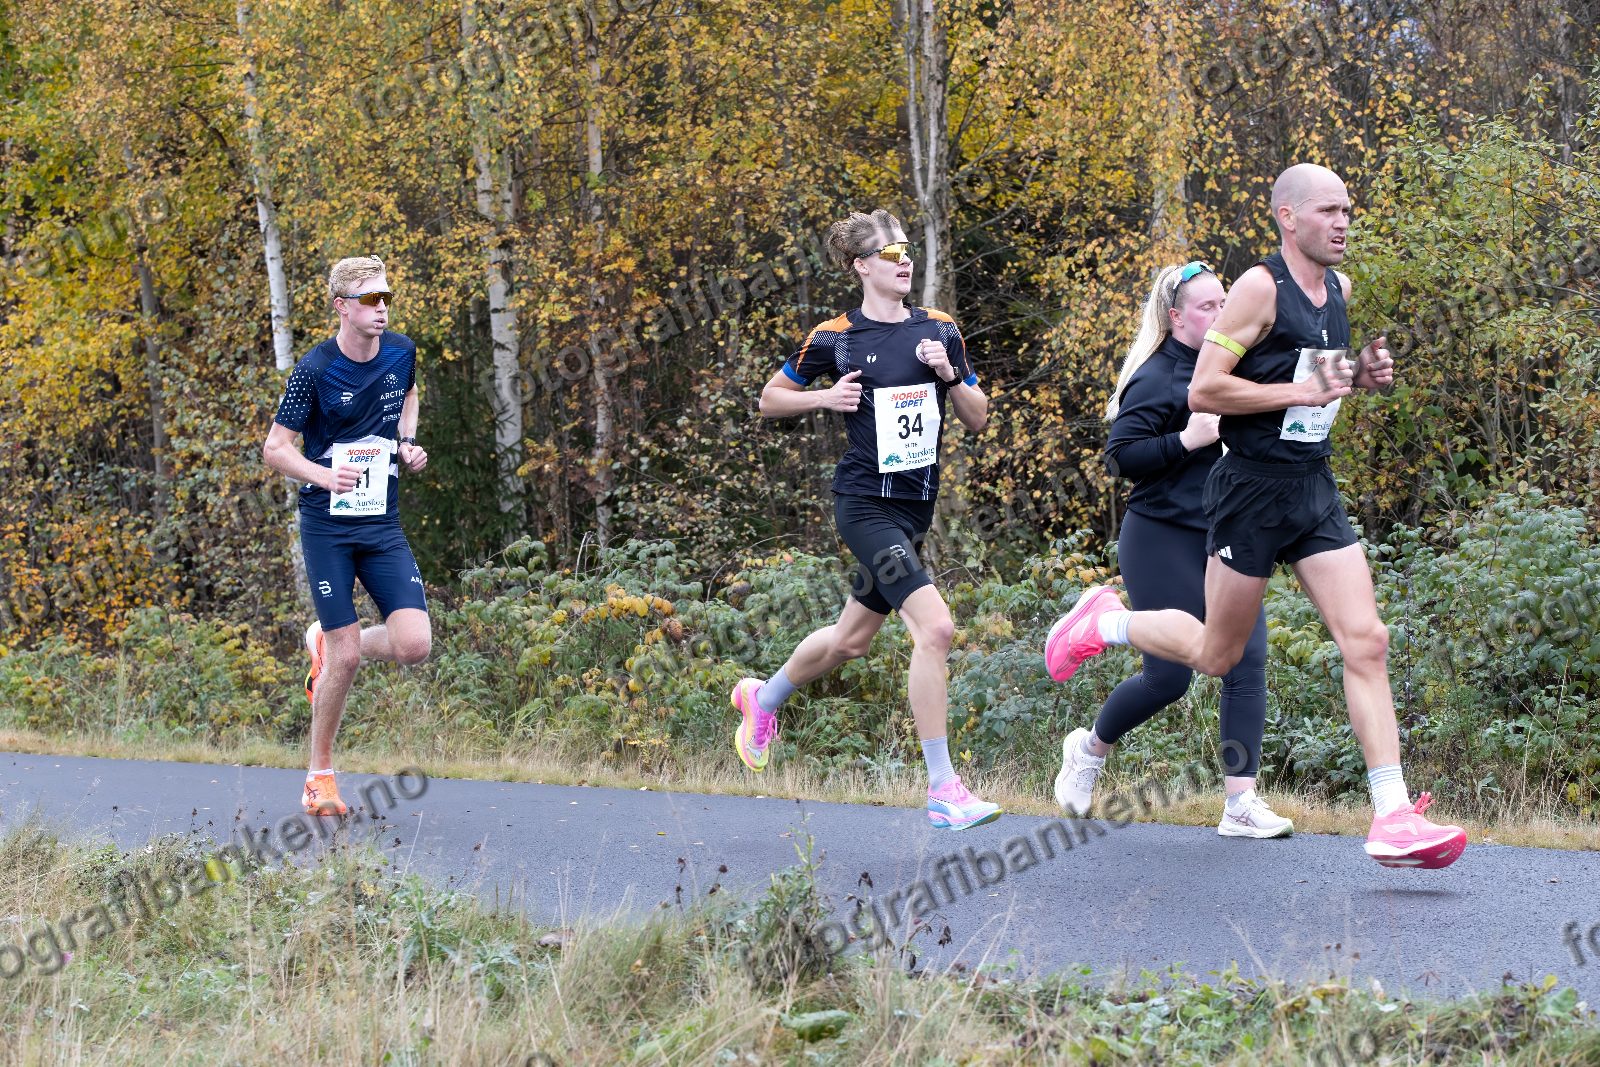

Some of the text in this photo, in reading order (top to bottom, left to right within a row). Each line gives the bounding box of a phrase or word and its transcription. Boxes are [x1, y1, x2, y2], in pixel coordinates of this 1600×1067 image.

[380, 389, 405, 400] ARCTIC
[890, 389, 928, 401] NORGES
[895, 399, 924, 409] LØPET
[898, 413, 924, 440] 34
[346, 448, 381, 456] NORGES
[349, 455, 376, 463] LØPET
